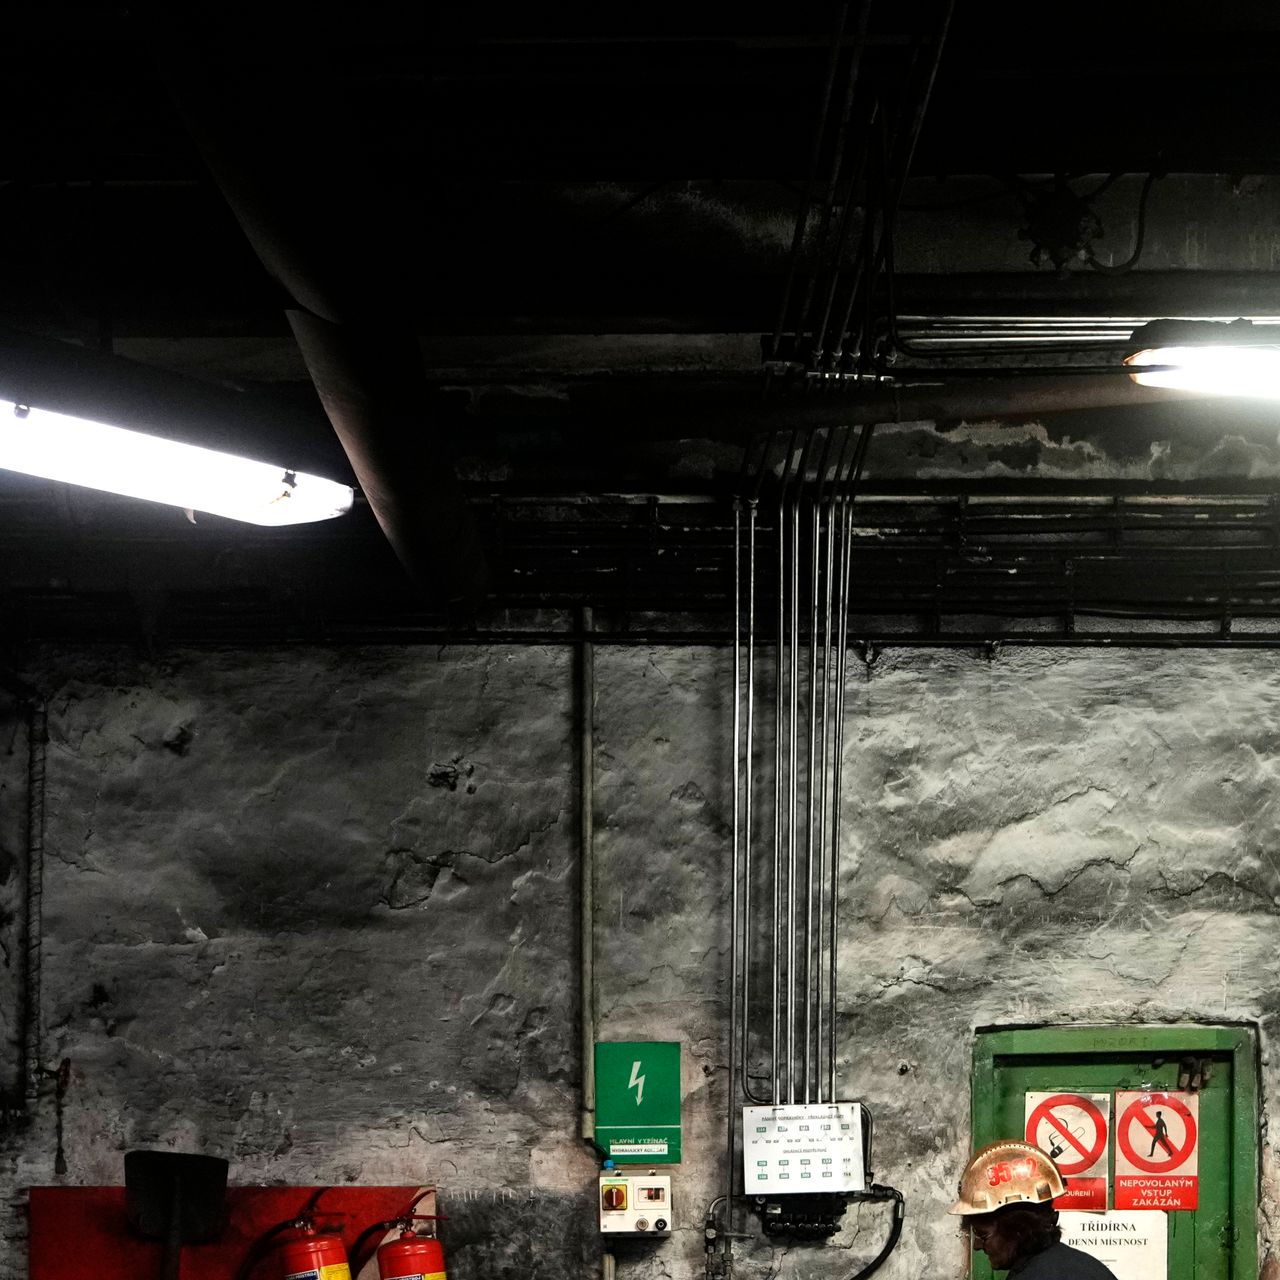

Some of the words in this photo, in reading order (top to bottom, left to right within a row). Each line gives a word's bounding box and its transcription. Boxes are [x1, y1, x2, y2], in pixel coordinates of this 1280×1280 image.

[1119, 1178, 1193, 1187] NEPOVOLANÝM
[1140, 1189, 1172, 1197] VSTUP
[1132, 1197, 1181, 1206] ZAKÁZÁN
[1080, 1221, 1137, 1232] TŘÍDÍRNA
[1068, 1236, 1098, 1246] DENNÍ
[1100, 1236, 1149, 1246] MÍSTNOST
